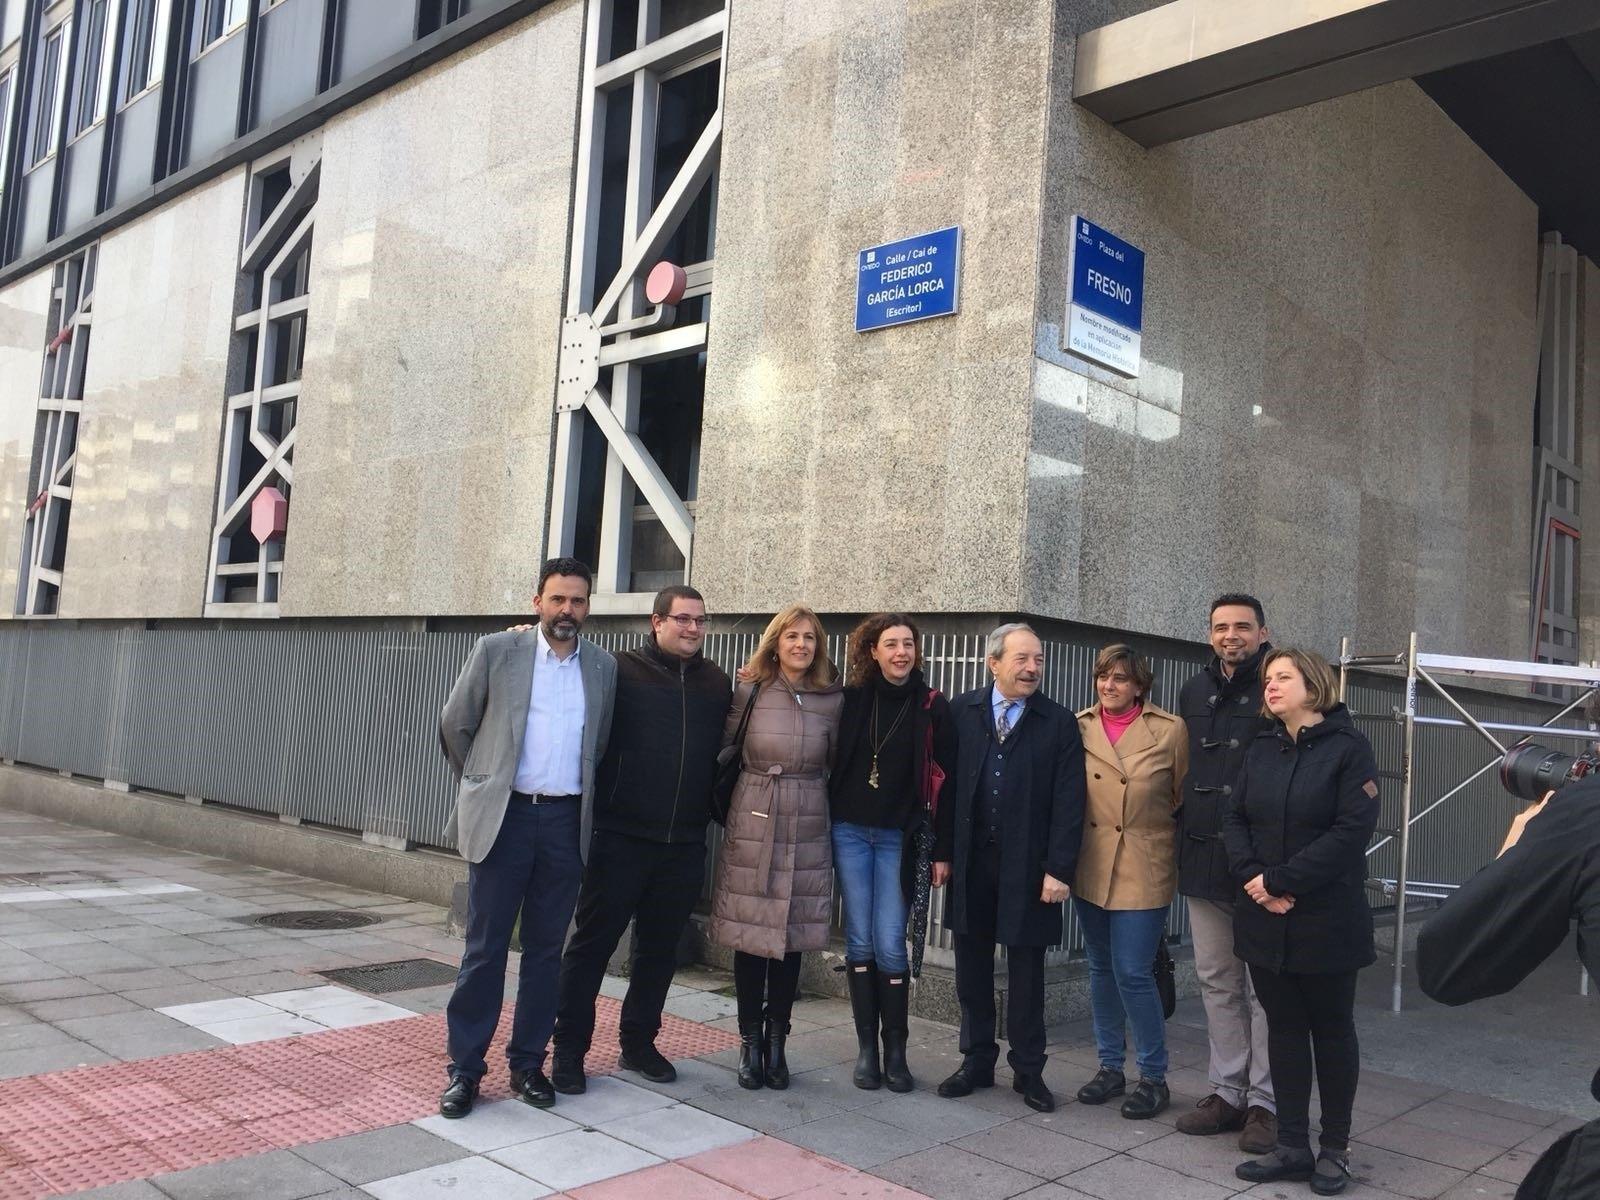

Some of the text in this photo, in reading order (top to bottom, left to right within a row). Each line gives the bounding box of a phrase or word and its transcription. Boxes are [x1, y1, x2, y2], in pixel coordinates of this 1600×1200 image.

[885, 253, 906, 265] Calle
[912, 247, 926, 259] Cai
[927, 246, 938, 255] de
[1099, 241, 1125, 262] Plaza del
[880, 262, 932, 284] FEDERICO
[867, 278, 944, 305] GARCÍA LORCA
[1087, 268, 1132, 305] FRESNO
[886, 301, 922, 318] (Escritor)
[1080, 313, 1132, 344] Nombre modificado
[1087, 331, 1095, 339] en
[1073, 337, 1081, 347] de
[1081, 340, 1087, 349] la
